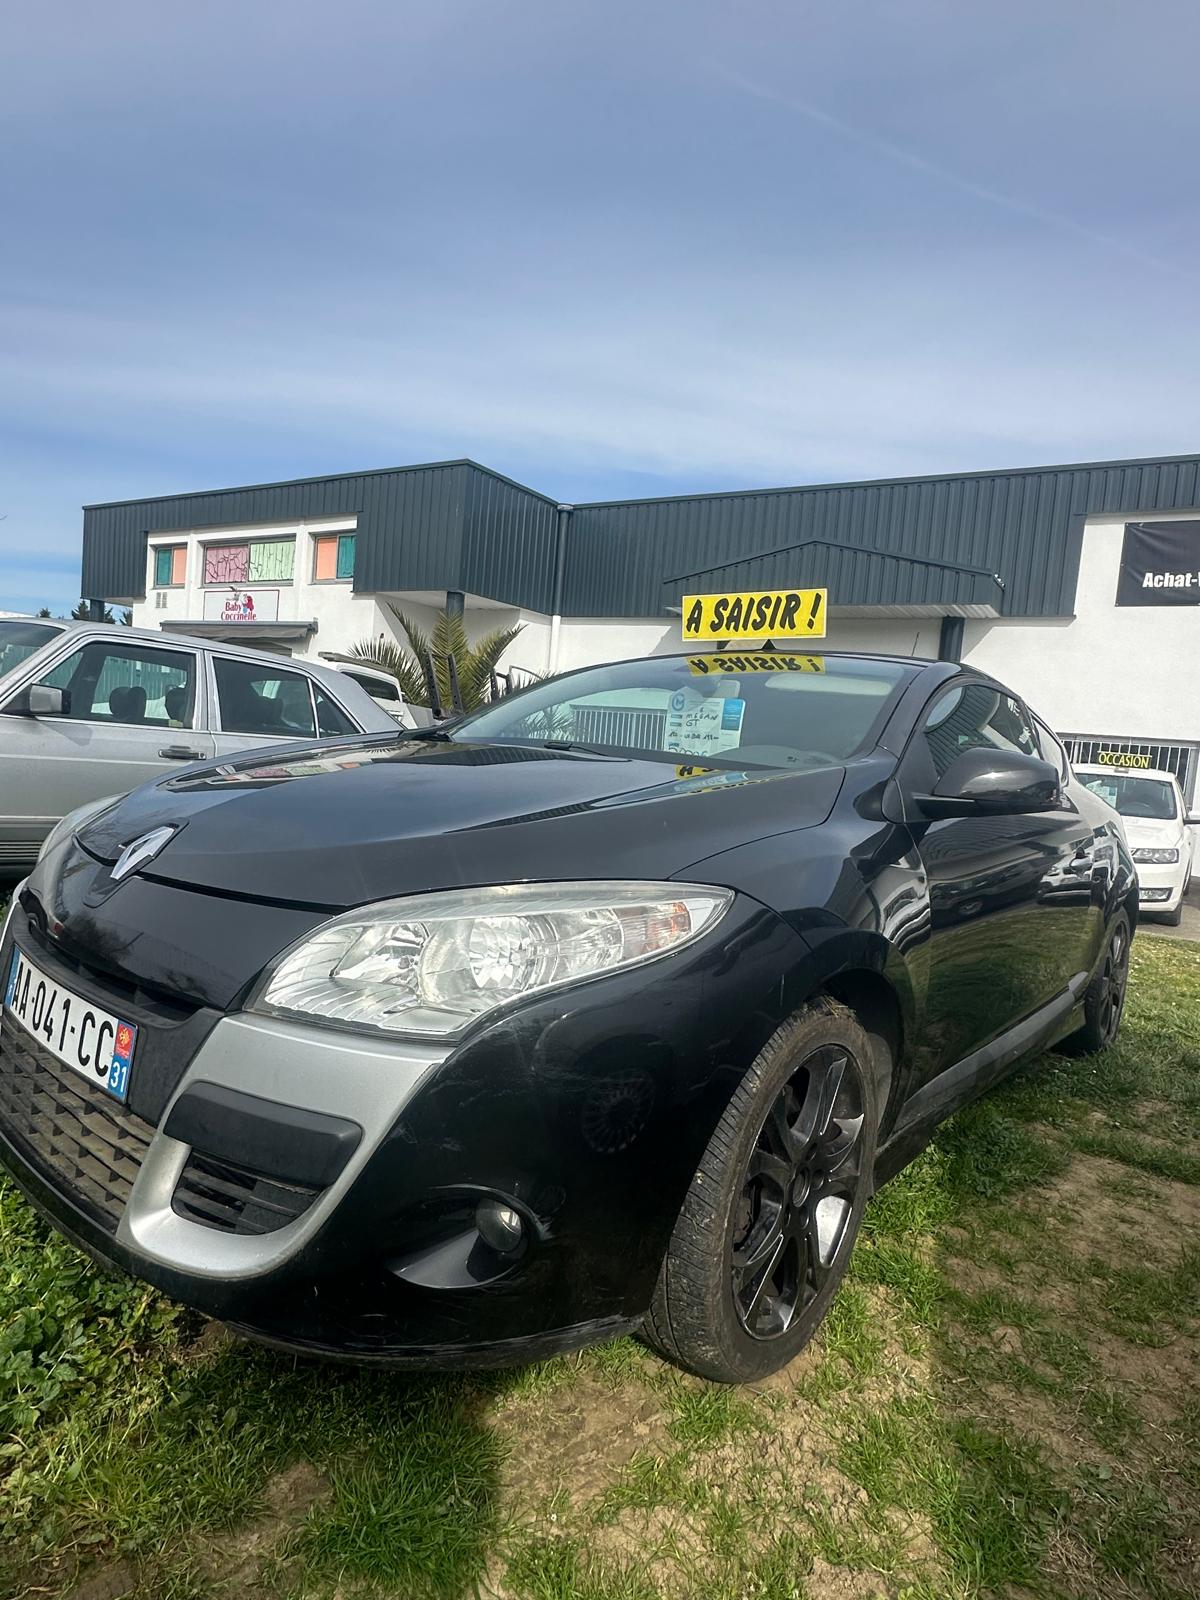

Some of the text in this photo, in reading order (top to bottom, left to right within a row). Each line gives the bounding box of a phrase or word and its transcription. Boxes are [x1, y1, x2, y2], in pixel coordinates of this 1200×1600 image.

[1142, 572, 1200, 588] Achat-
[225, 601, 241, 613] Baby
[686, 592, 822, 633] A SAISIR !
[221, 611, 257, 621] Coccinelle
[1098, 752, 1150, 769] OCCASION
[11, 961, 114, 1077] AA-041-CC
[110, 1061, 127, 1093] 31
